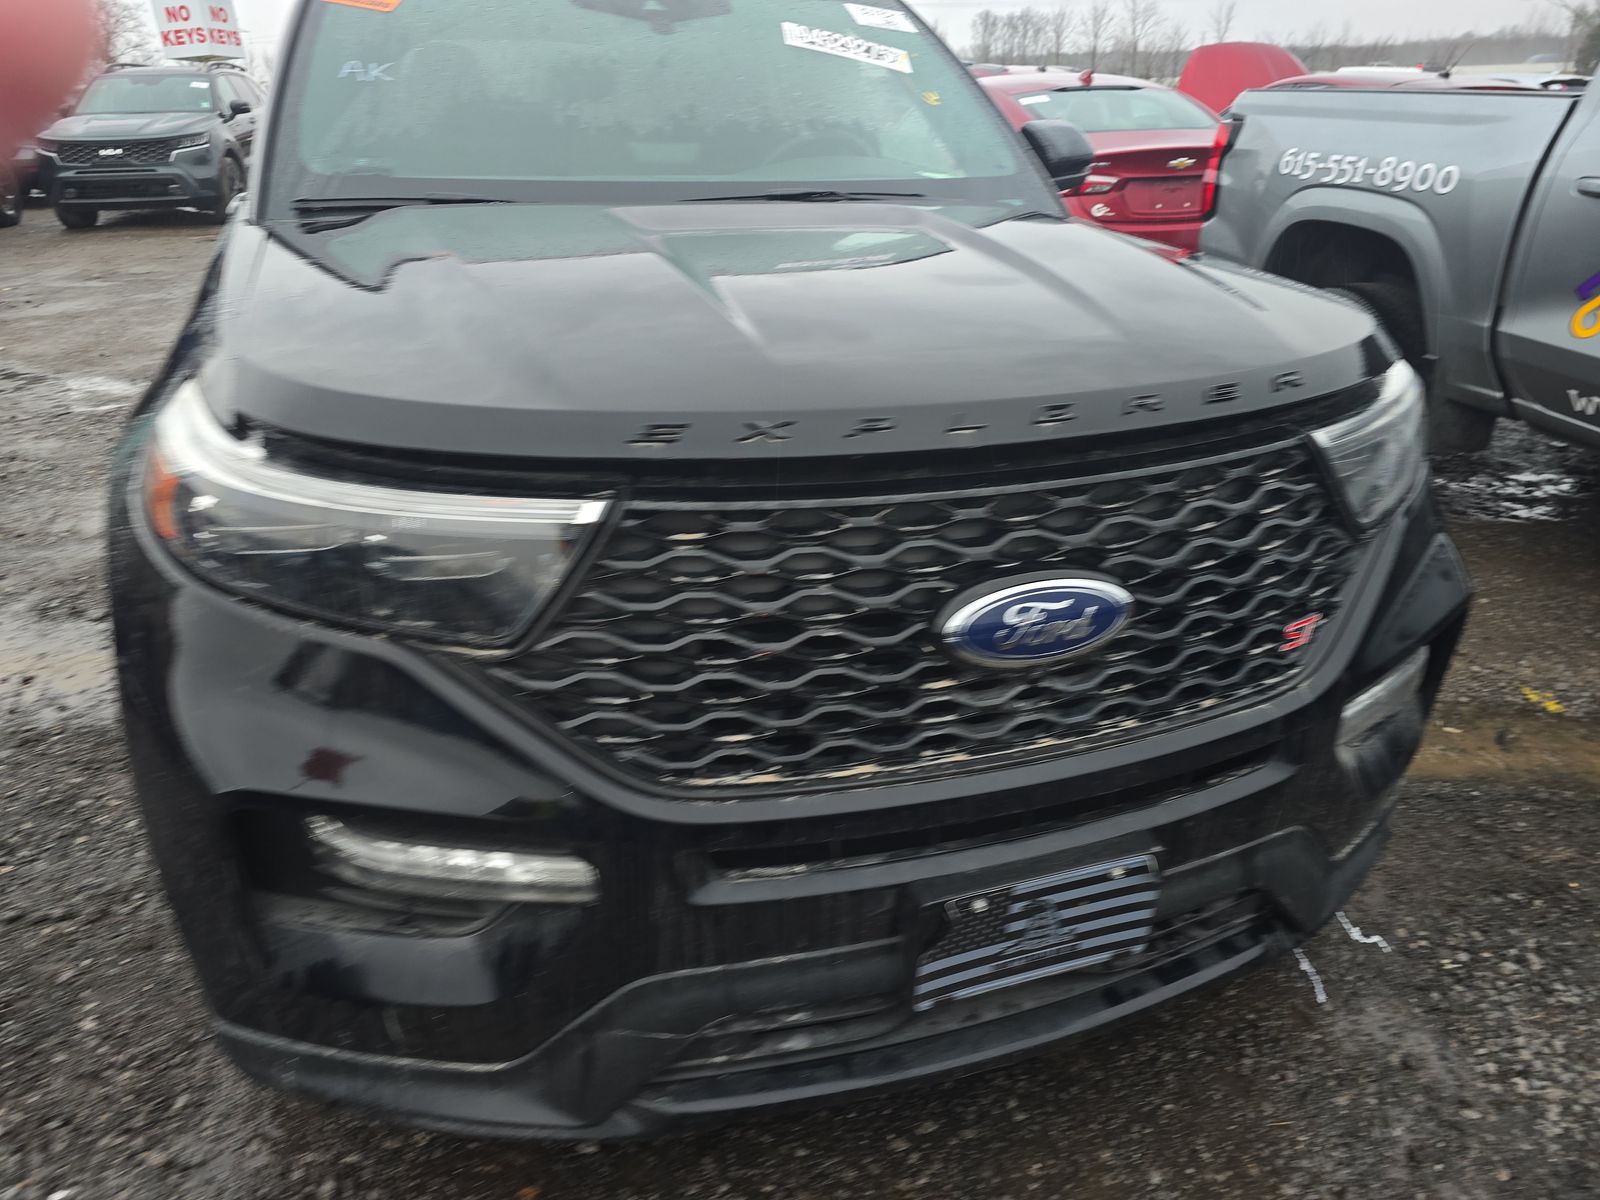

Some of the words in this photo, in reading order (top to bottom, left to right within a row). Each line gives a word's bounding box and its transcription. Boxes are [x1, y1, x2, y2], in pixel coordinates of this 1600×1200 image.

[163, 5, 191, 23] NO
[208, 5, 229, 23] NO
[160, 27, 207, 47] KEYS
[207, 28, 242, 46] KEYS
[1278, 147, 1461, 195] 615-551-8900
[993, 598, 1100, 650] Ford
